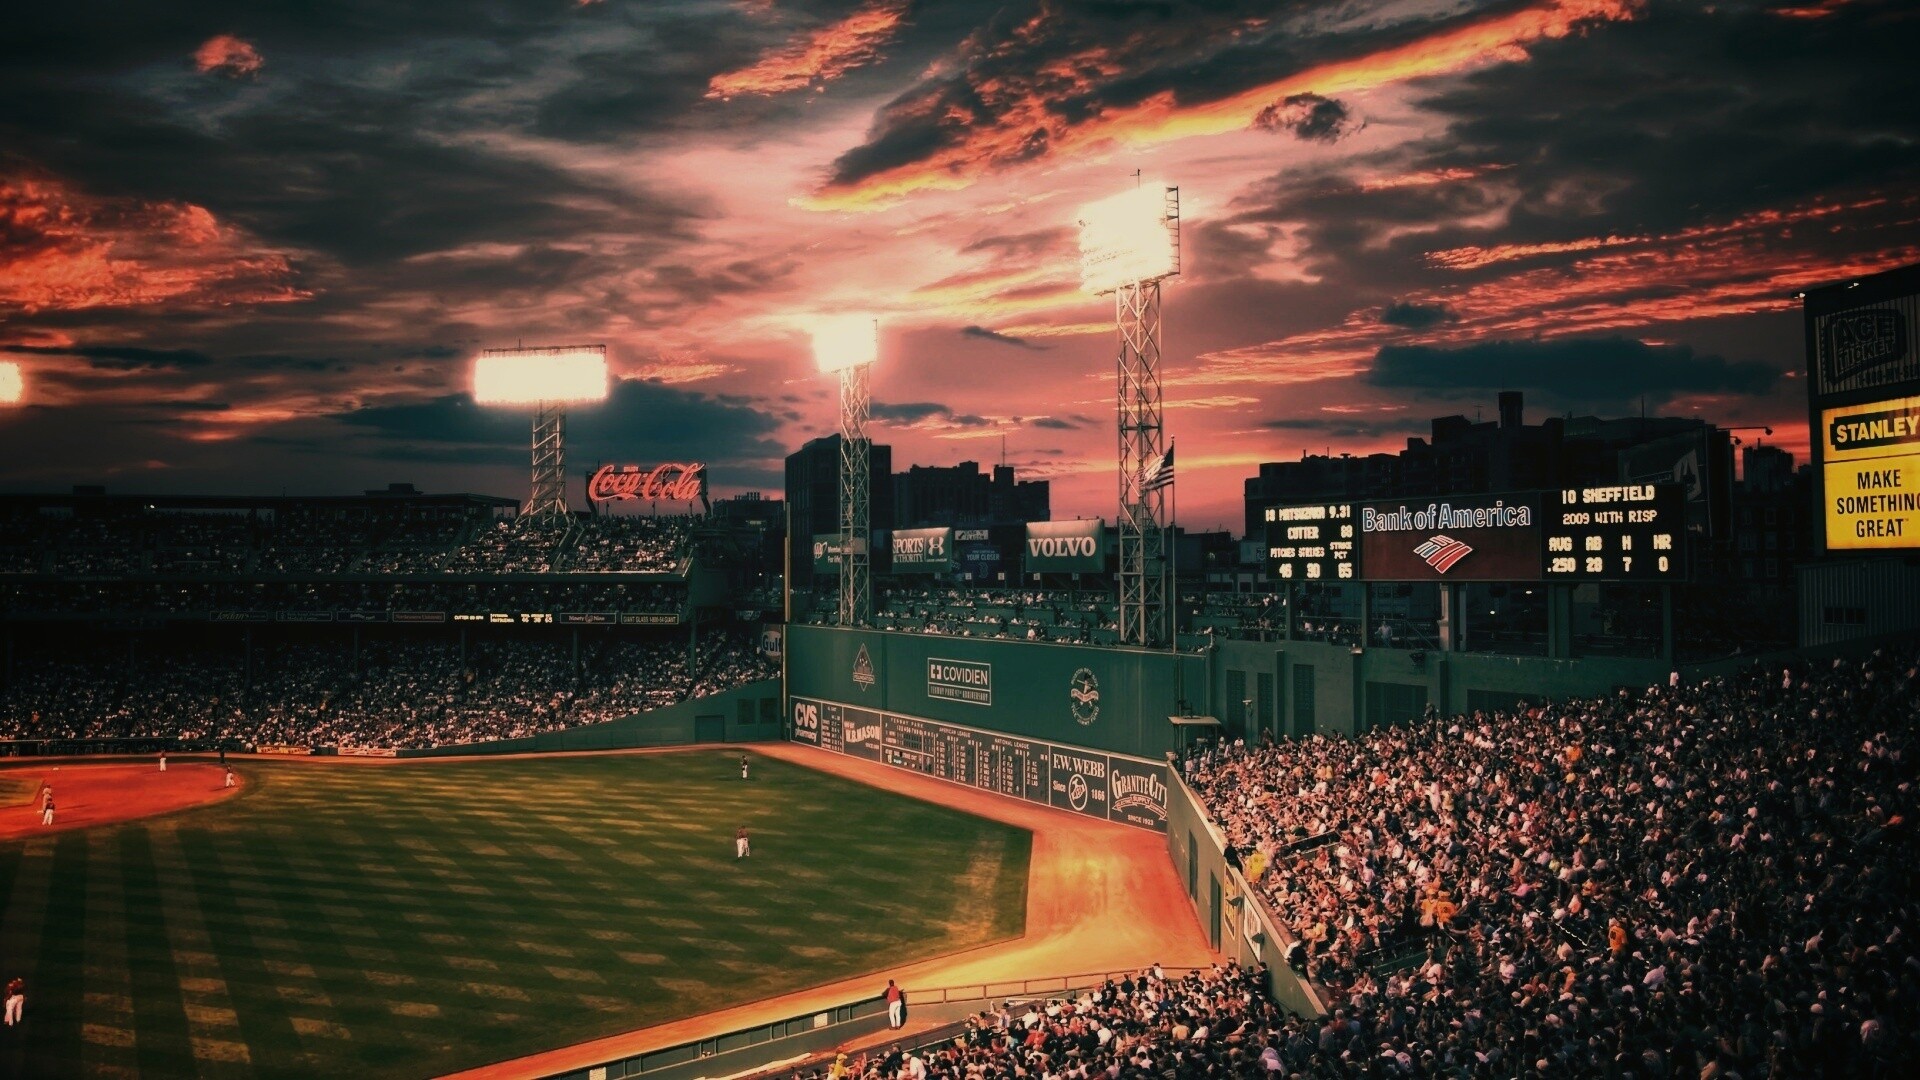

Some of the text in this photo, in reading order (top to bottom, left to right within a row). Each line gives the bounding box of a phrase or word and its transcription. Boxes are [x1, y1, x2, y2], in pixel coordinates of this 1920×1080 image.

[1836, 415, 1920, 444] STANLEY
[588, 462, 706, 501] Coca-Cola
[1857, 469, 1902, 490] MAKE
[1562, 485, 1656, 505] 10 SHEFFIELD
[1328, 504, 1351, 519] 9.31
[1362, 500, 1532, 532] Bank of America
[1562, 509, 1658, 525] 2009 WITH RISP
[1287, 526, 1320, 540] CUTTER
[1856, 518, 1904, 538] GREAT
[1028, 536, 1097, 557] VOLVO
[1270, 546, 1325, 558] PITCHES STRIKES
[1585, 535, 1603, 551] AB
[1621, 534, 1632, 551] H
[1653, 533, 1672, 550] HR
[1333, 550, 1348, 560] PCT
[1547, 555, 1669, 573] .250 28 7 0
[943, 665, 988, 686] COVIDIEN
[794, 702, 818, 730] CVS
[1072, 756, 1105, 779] WEBB
[1127, 814, 1142, 824] SINCE
